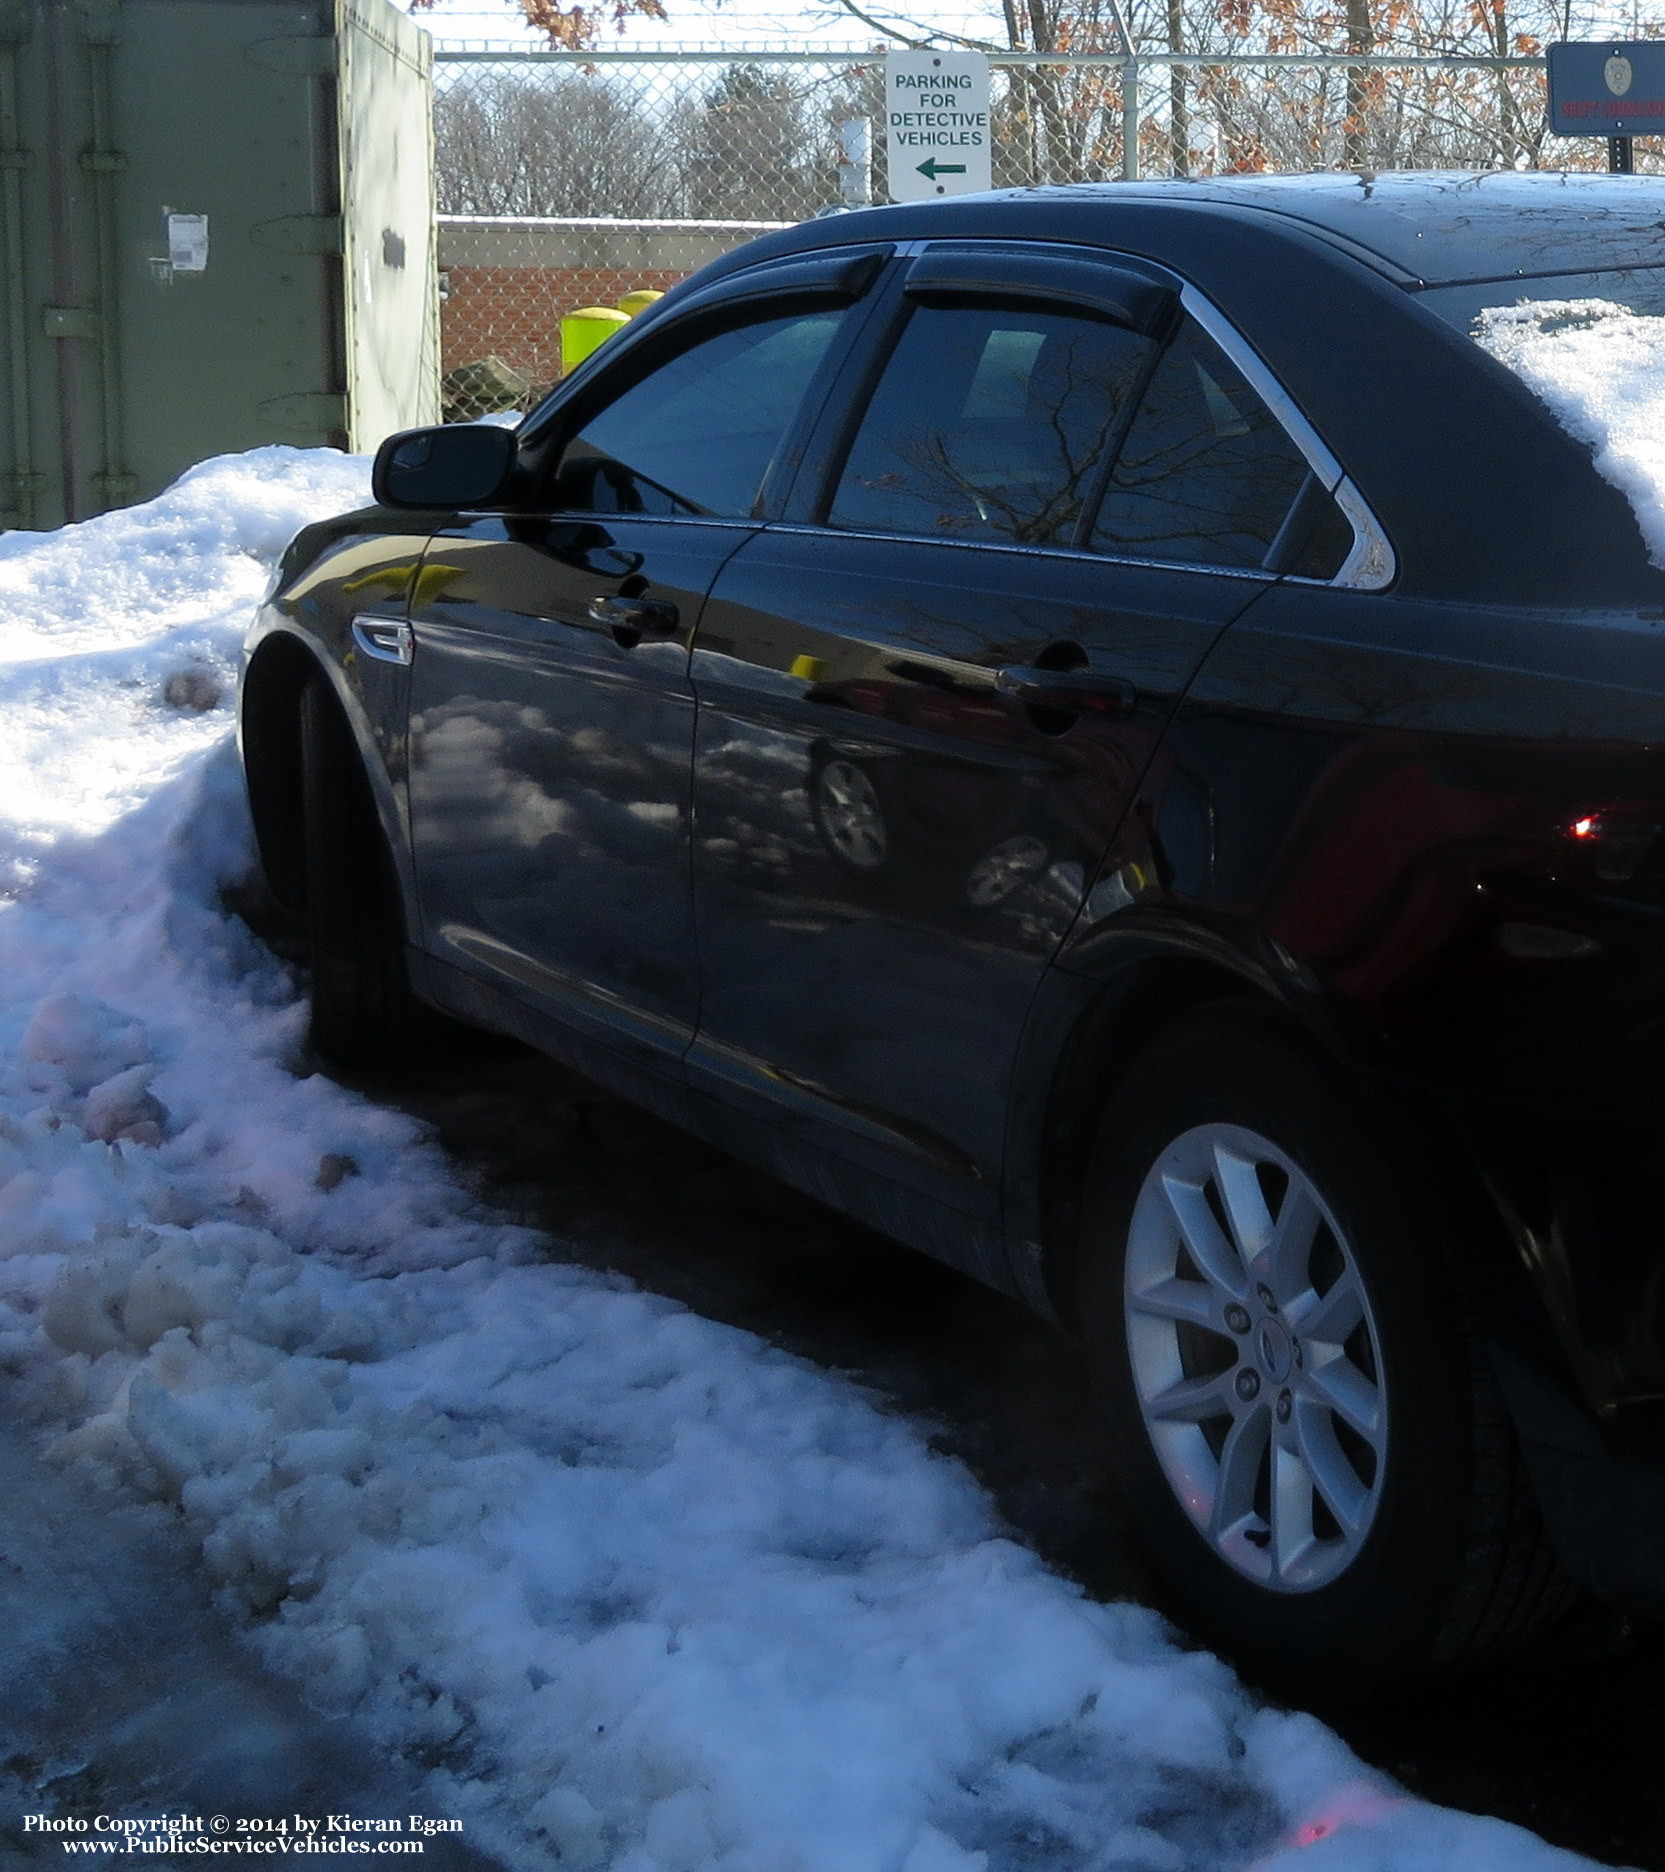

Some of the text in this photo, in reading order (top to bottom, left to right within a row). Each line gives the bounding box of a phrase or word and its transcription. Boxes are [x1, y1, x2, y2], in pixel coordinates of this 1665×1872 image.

[896, 75, 972, 89] PARKING
[920, 94, 956, 108] FOR
[891, 112, 987, 127] DETECTIVE
[896, 131, 983, 146] VEHICLES
